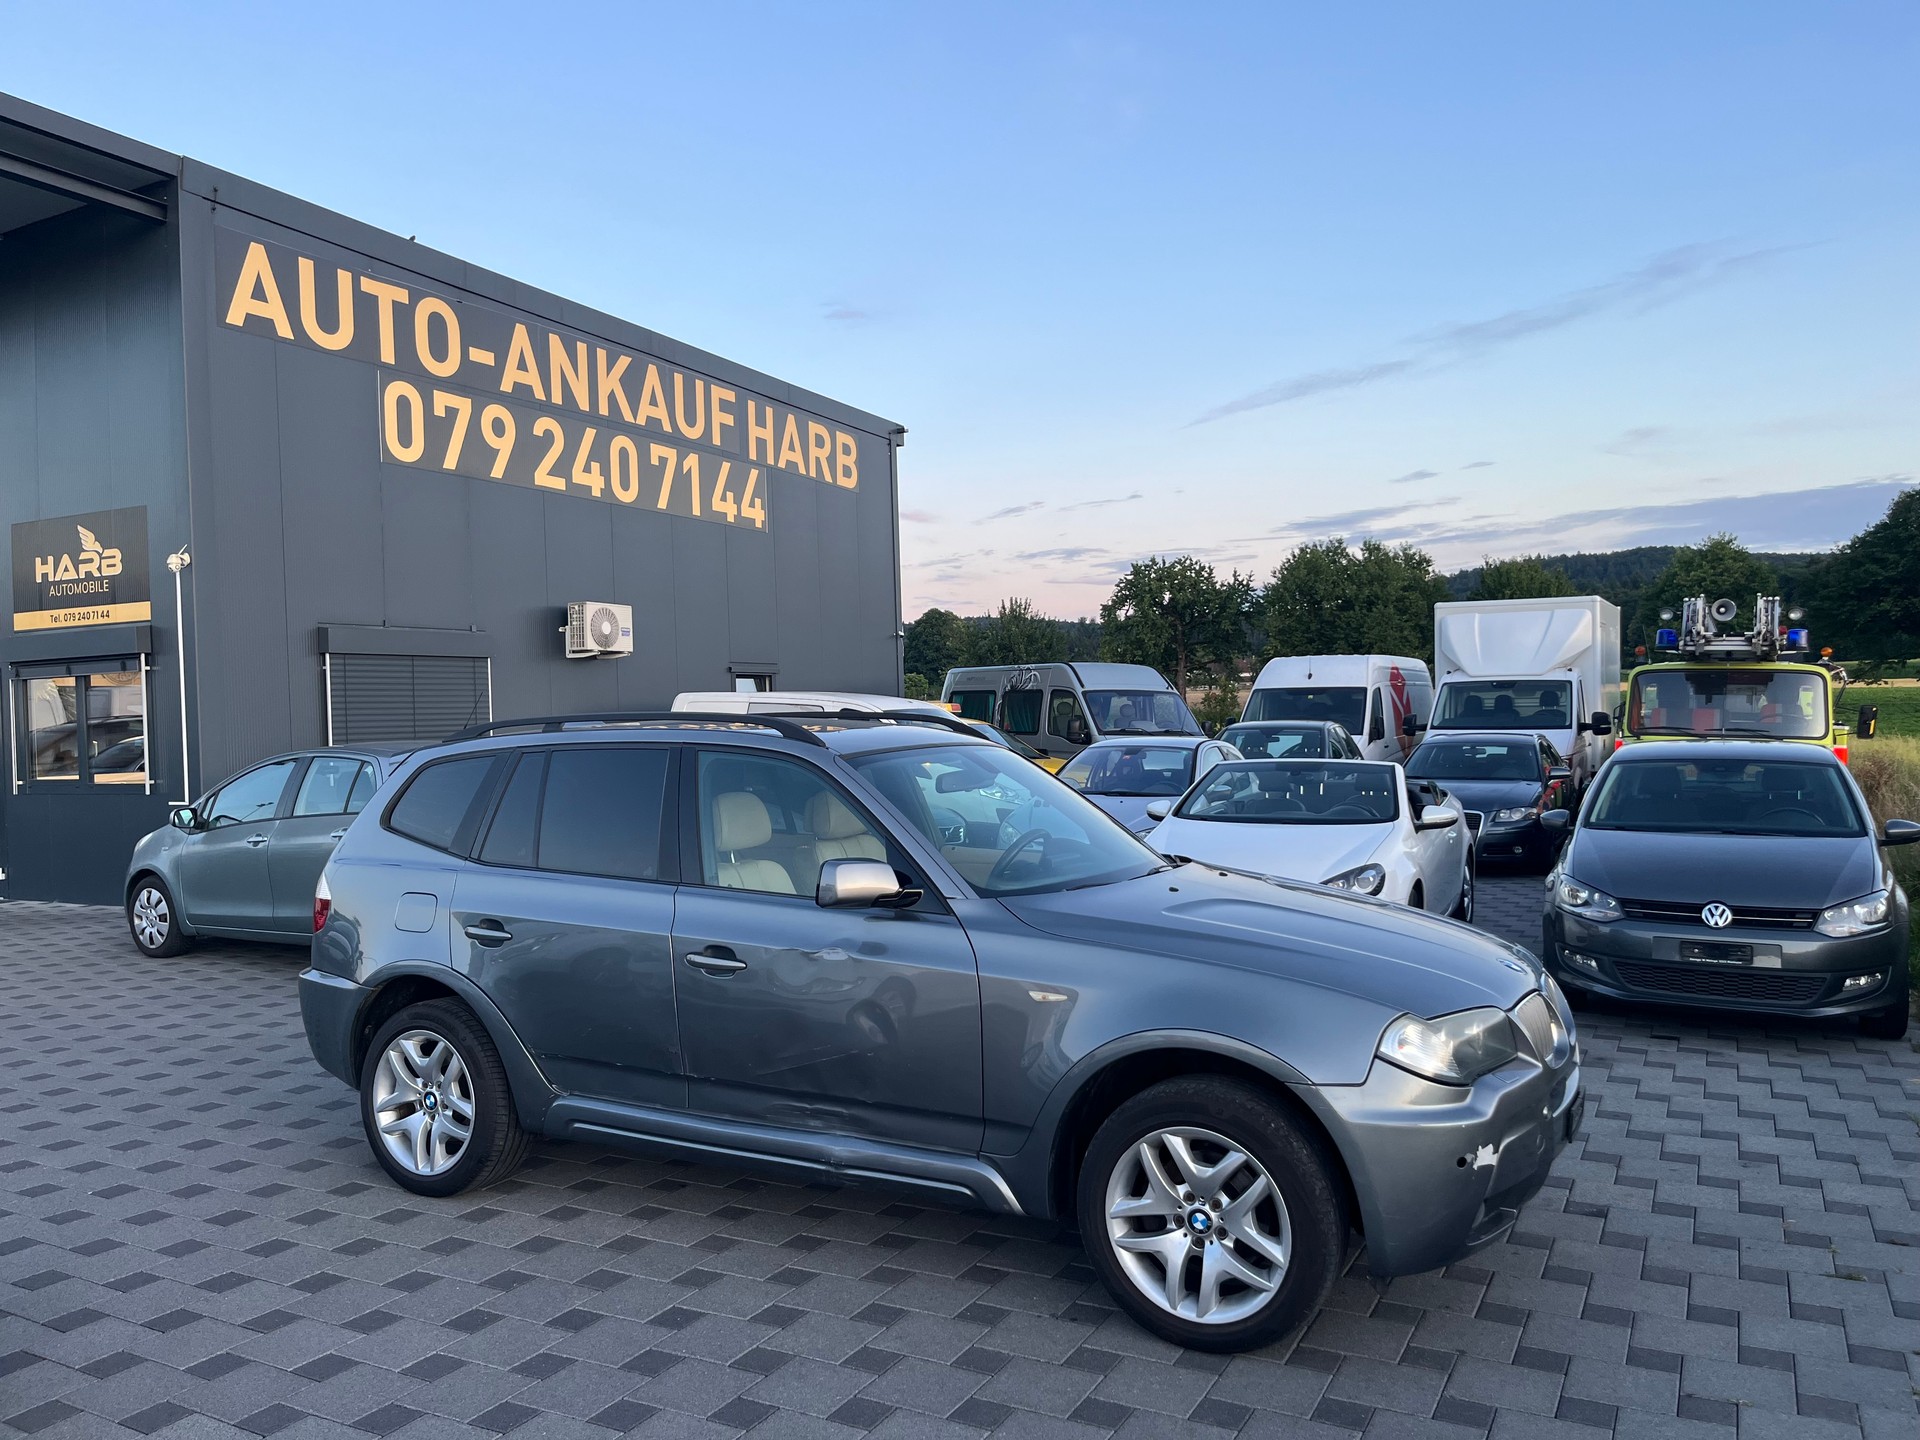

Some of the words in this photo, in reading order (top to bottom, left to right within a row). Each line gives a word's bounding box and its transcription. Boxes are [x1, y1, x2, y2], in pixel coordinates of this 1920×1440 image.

[226, 242, 736, 446] AUTO-ANKAUF
[747, 399, 859, 490] HARB
[383, 380, 517, 479] 079
[532, 416, 640, 504] 240
[649, 443, 702, 517] 71
[711, 461, 766, 529] 44
[35, 548, 123, 583] HARB
[49, 579, 109, 597] AUTOMOBILE
[50, 614, 62, 624] Tel.
[63, 612, 76, 622] 079
[77, 611, 91, 621] 240
[92, 610, 99, 620] 71
[100, 609, 110, 619] 44
[1701, 903, 1732, 928] VW
